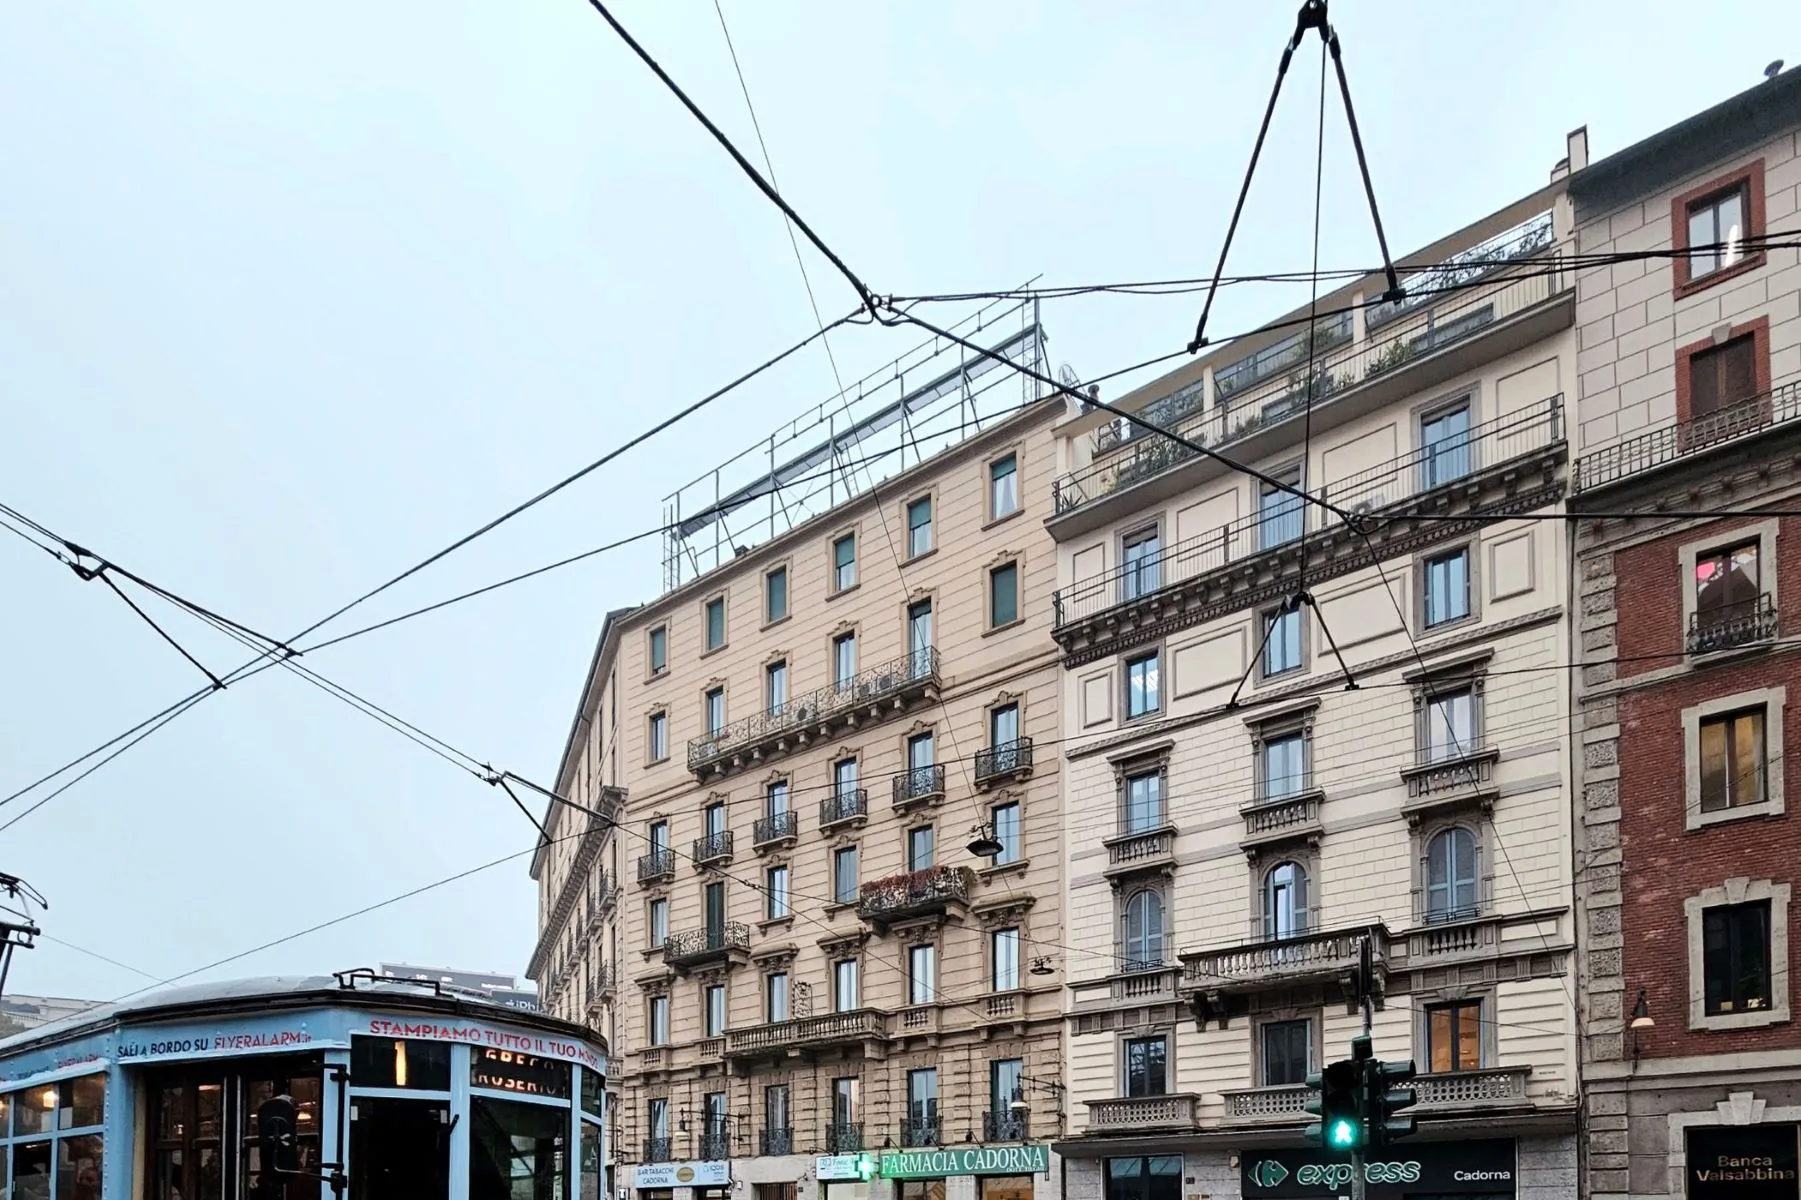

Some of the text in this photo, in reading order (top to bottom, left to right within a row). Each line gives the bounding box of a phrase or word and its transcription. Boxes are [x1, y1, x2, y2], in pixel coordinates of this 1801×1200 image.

[370, 1020, 481, 1041] STAMPIAMO
[484, 1029, 532, 1050] TUTTO
[535, 1039, 546, 1054] IL
[549, 1041, 577, 1058] TUO
[117, 1044, 139, 1058] SALI
[140, 1046, 147, 1056] A
[150, 1040, 192, 1055] BORDO
[195, 1038, 209, 1051] SU
[881, 1151, 959, 1174] FARMACIA
[963, 1146, 1044, 1170] CADORNA
[1718, 1155, 1773, 1167] Banca
[637, 1168, 649, 1176] BAR
[1297, 1161, 1422, 1191] expess
[1453, 1169, 1511, 1181] Cadorna
[1696, 1168, 1795, 1181] Valsabbina
